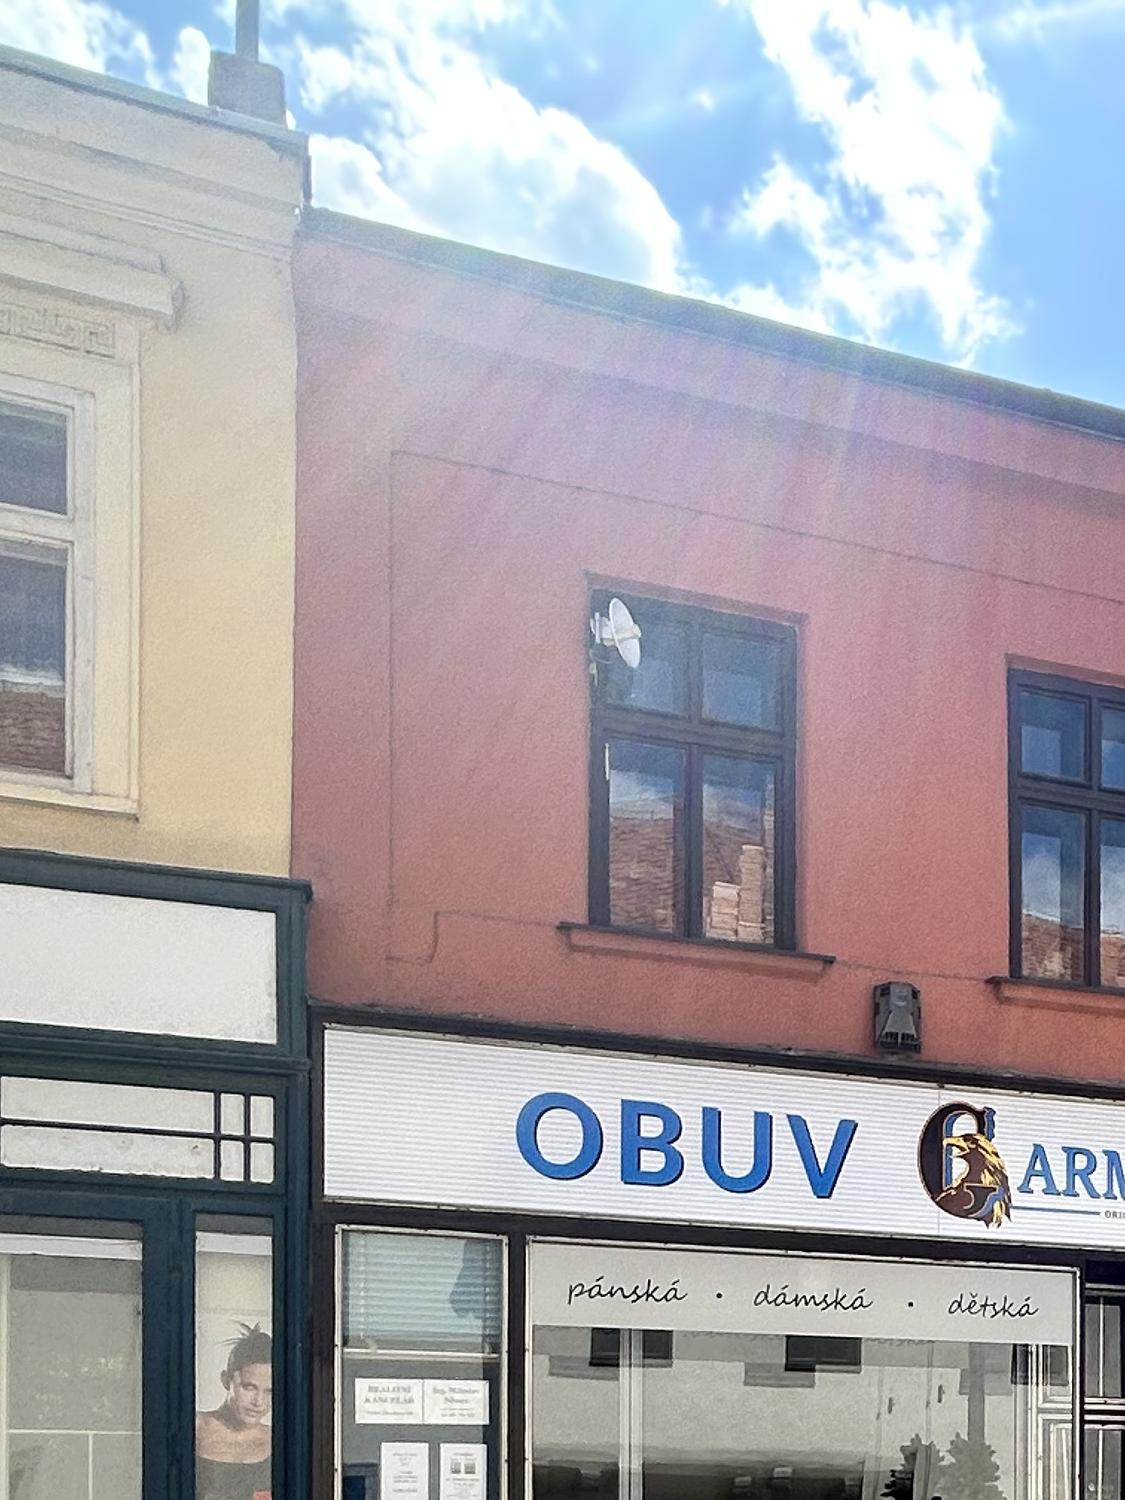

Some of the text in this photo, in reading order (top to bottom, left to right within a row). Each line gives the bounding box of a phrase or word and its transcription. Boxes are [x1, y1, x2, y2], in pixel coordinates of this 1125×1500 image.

[516, 1092, 858, 1199] OBUV
[567, 1275, 1039, 1319] pánská dámská dětská
